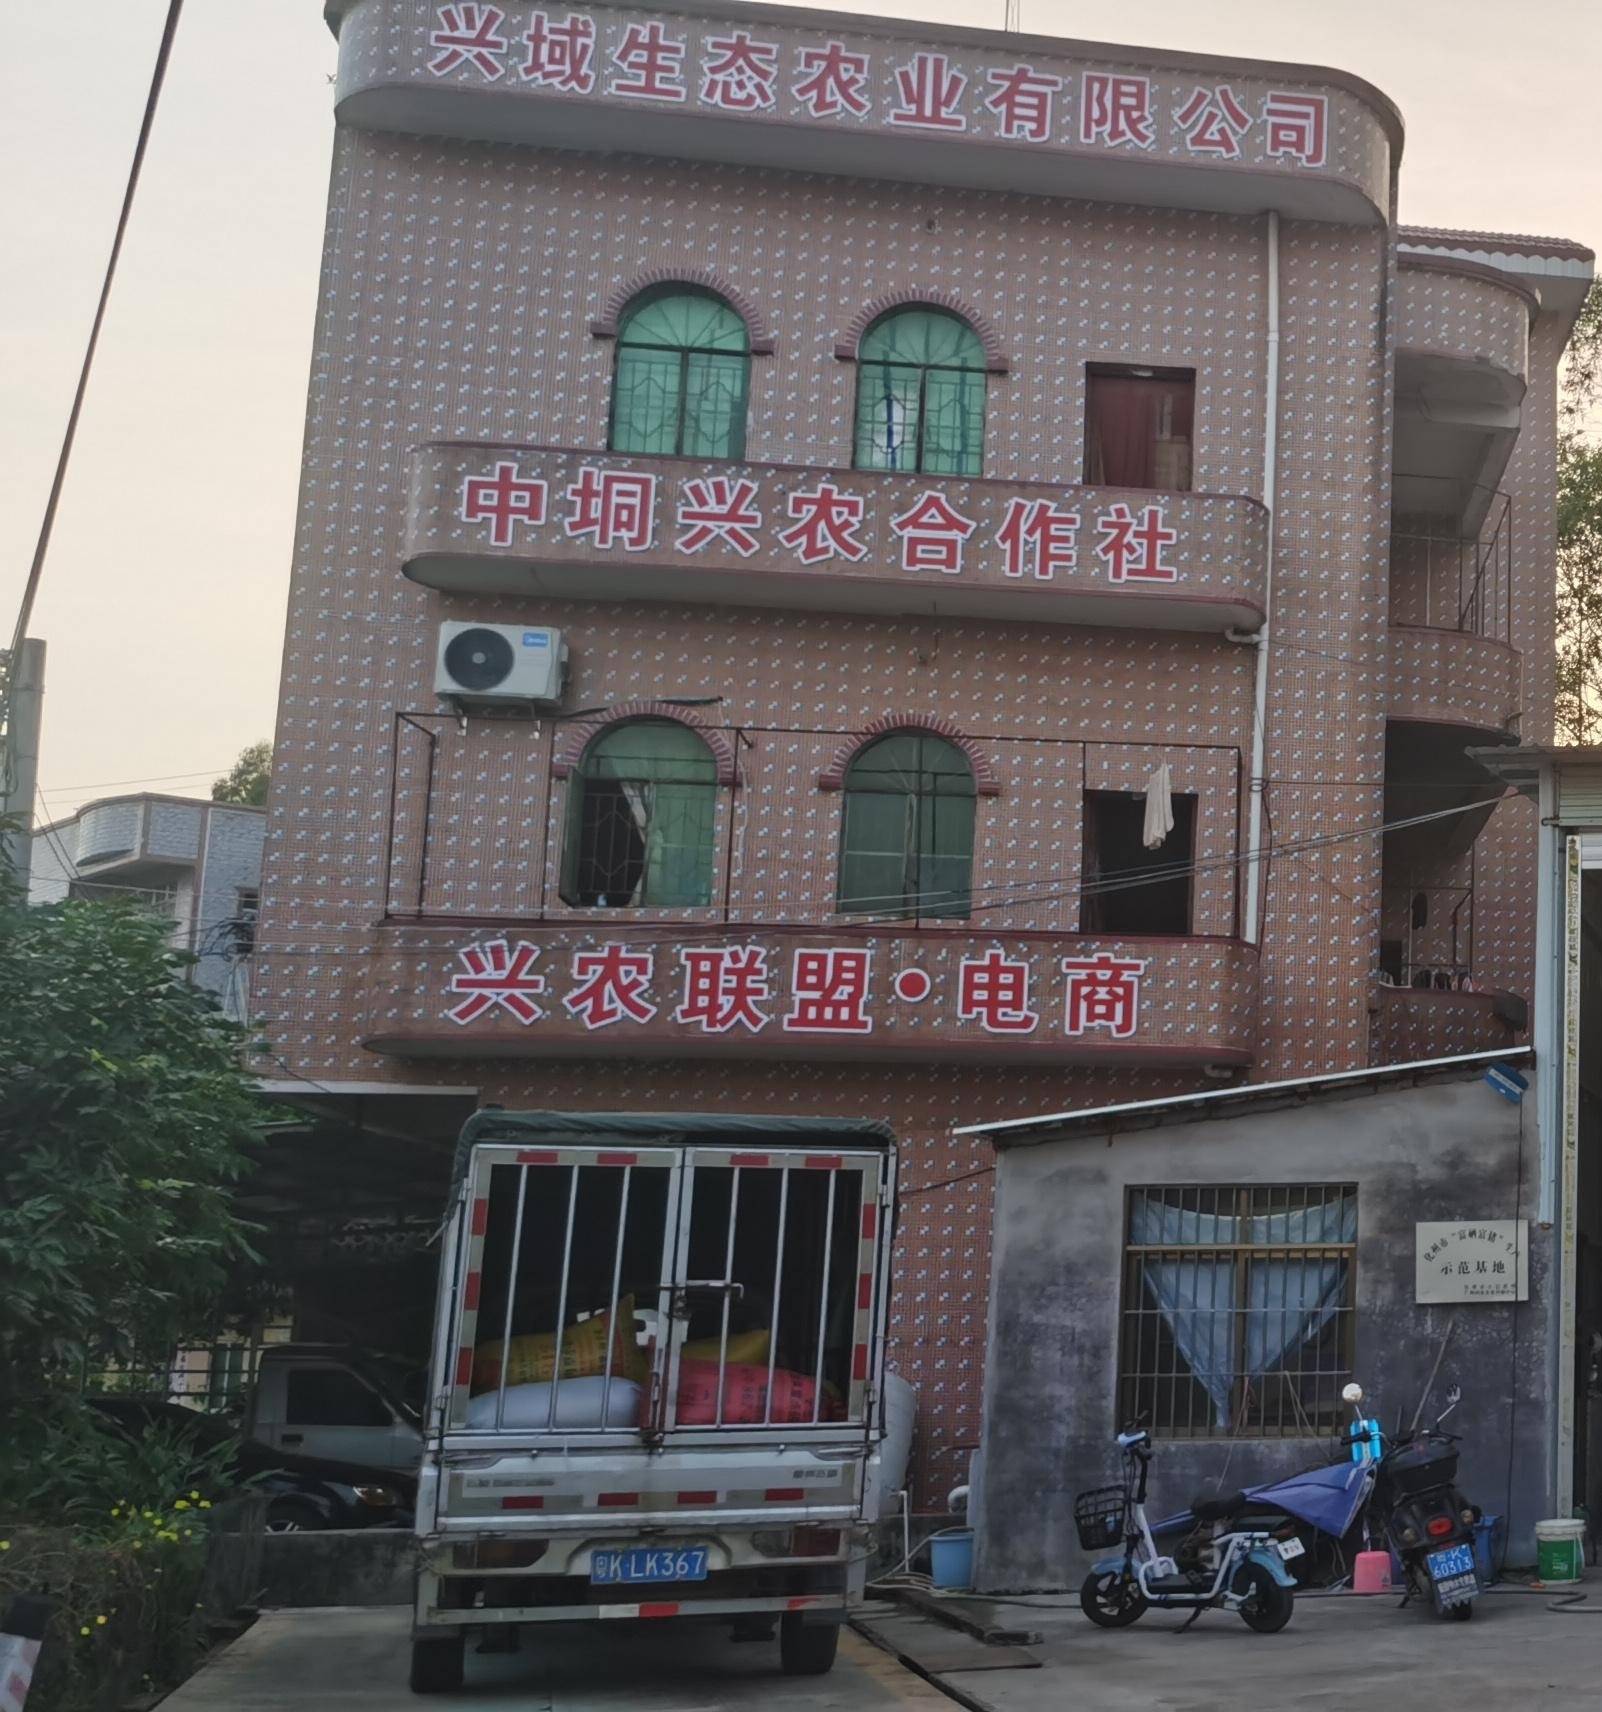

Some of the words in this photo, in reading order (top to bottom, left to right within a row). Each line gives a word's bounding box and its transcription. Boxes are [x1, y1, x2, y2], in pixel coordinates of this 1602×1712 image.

[427, 2, 1329, 168] 兴域生态农业有限公司
[462, 461, 1178, 583] 中垌兴农合作社
[1440, 1260, 1506, 1275] 示范基地
